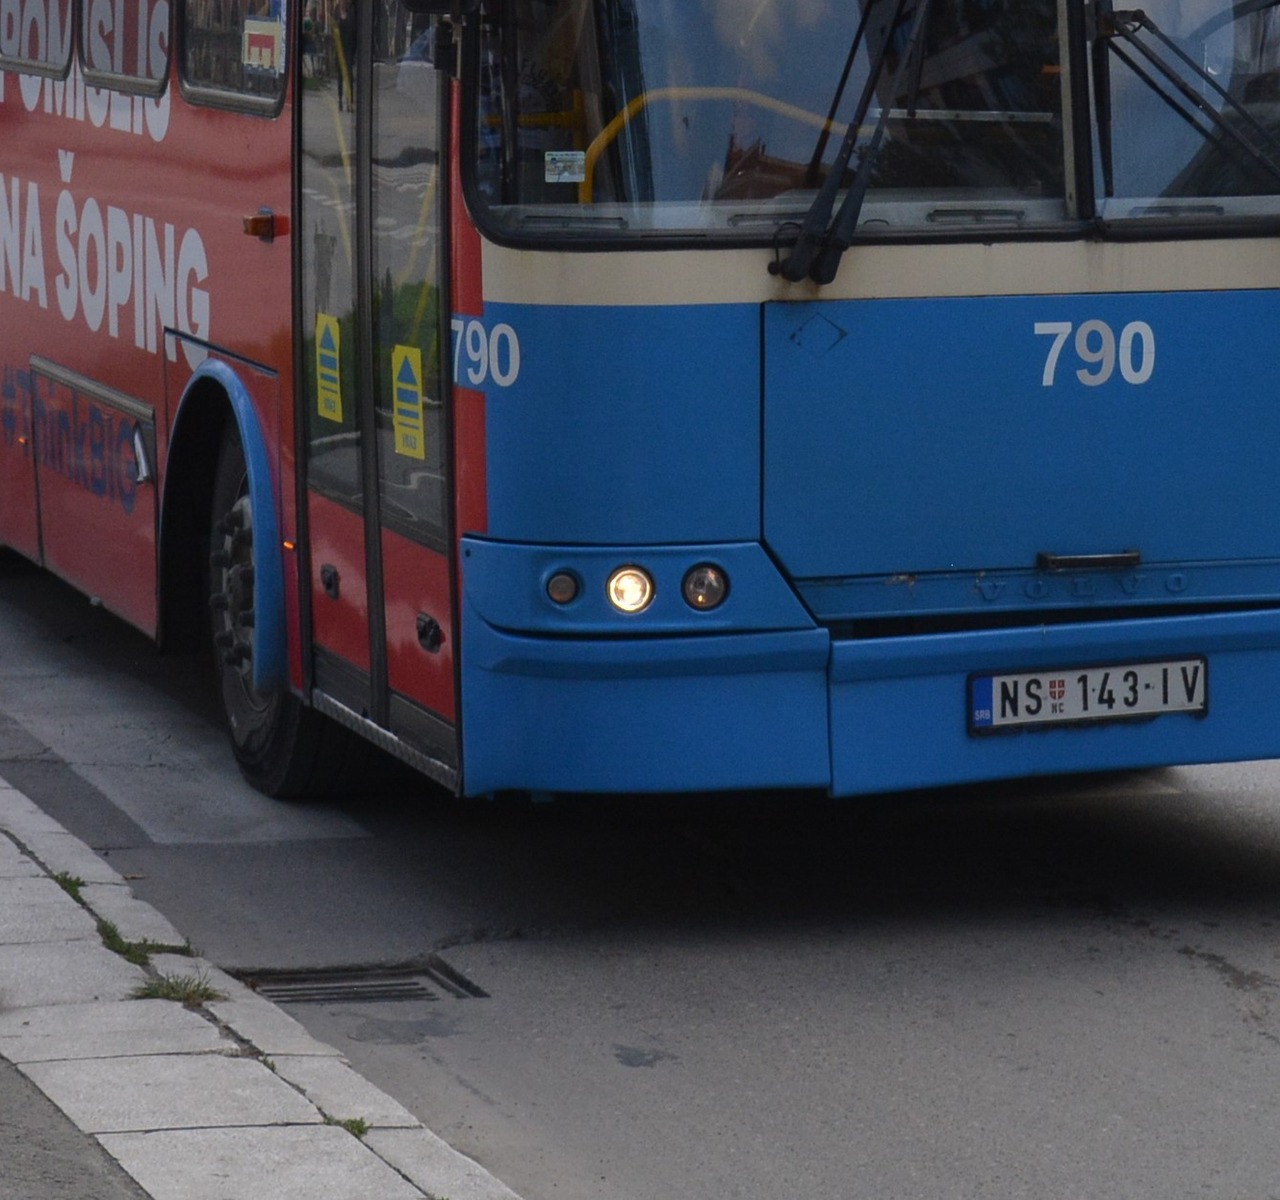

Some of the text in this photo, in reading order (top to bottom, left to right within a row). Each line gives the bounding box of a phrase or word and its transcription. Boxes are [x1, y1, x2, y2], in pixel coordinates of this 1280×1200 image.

[55, 148, 211, 373] ŠOPING
[450, 318, 520, 387] 790
[1033, 319, 1156, 387] 790
[975, 709, 991, 720] SRB
[1000, 678, 1043, 718] NS
